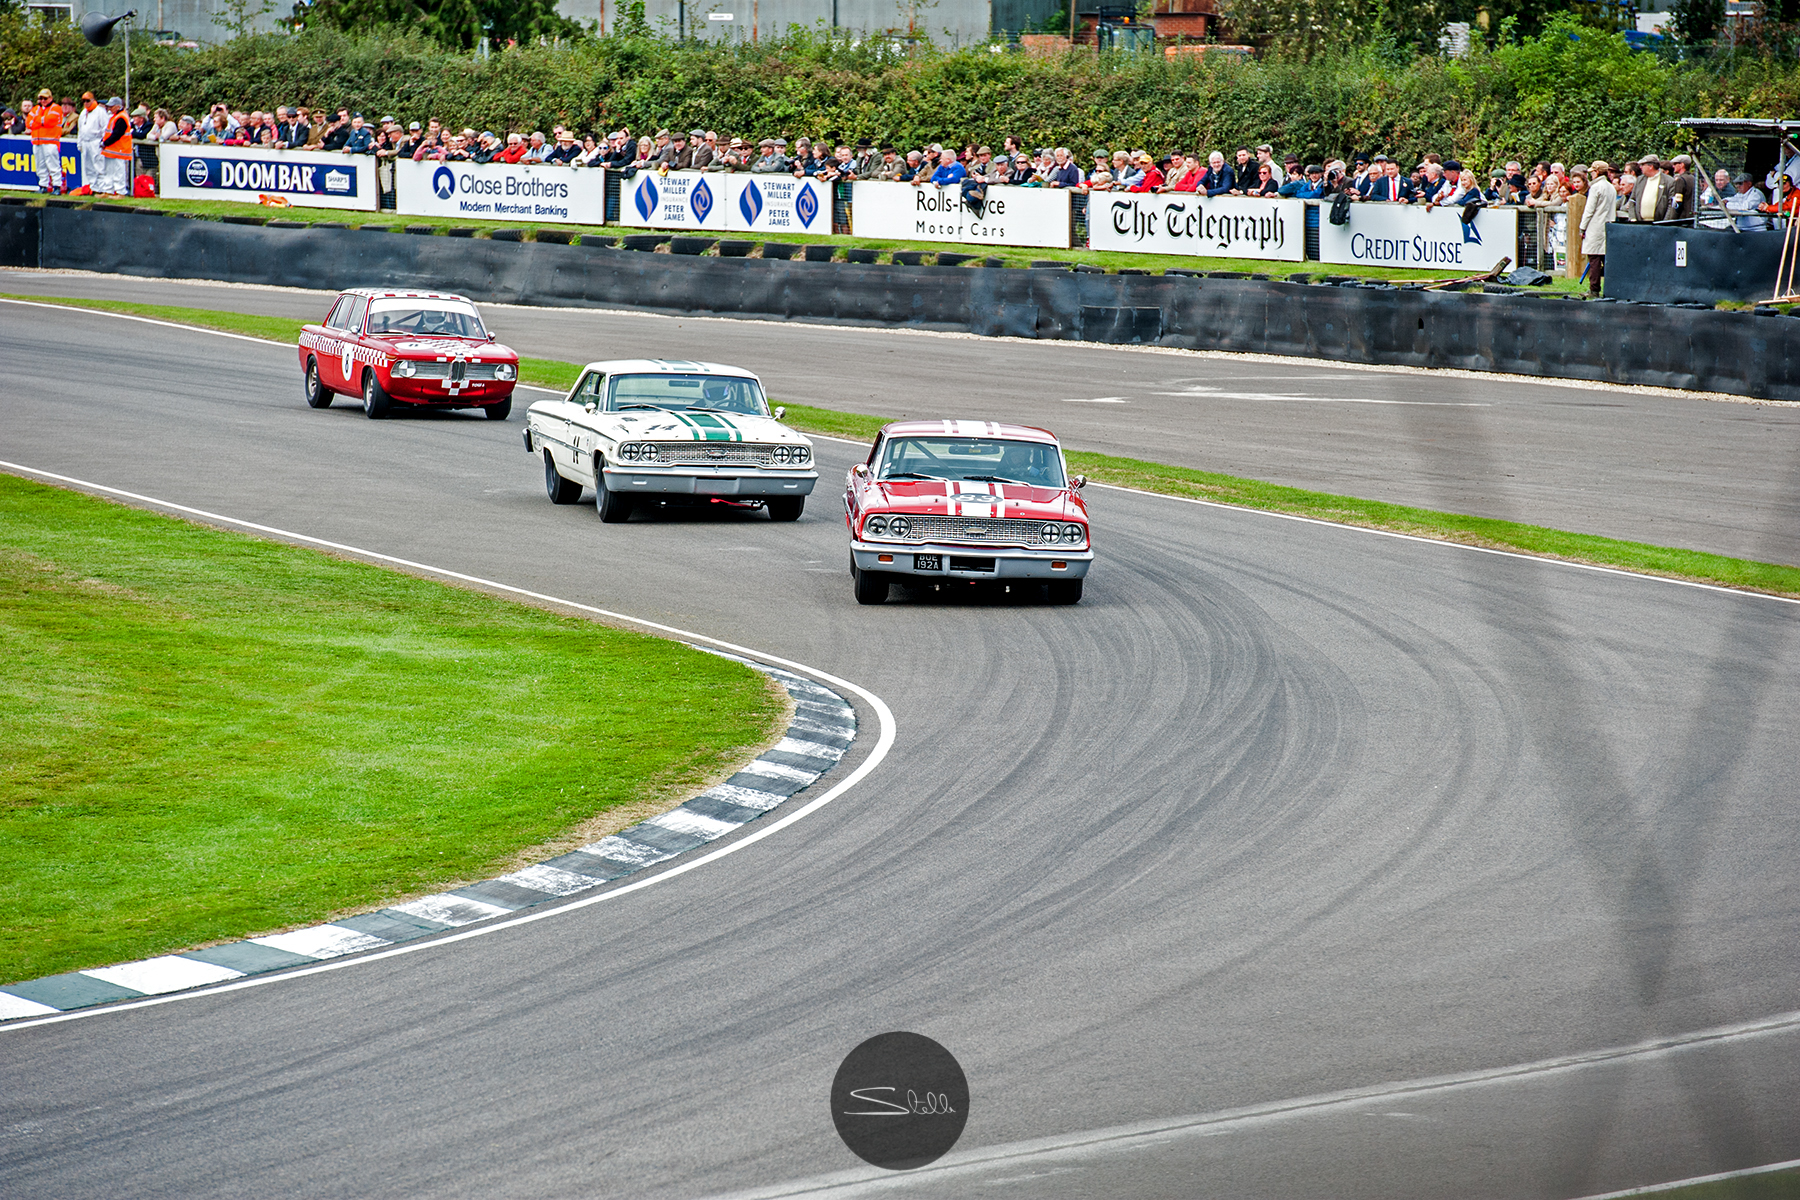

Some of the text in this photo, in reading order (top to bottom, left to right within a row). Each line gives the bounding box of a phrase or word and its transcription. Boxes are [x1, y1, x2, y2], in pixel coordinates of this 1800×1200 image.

[221, 161, 276, 189] DOOM
[278, 164, 315, 191] BAR
[460, 174, 568, 198] Close Brothers
[659, 177, 690, 186] STEWART
[763, 182, 795, 190] STEWART
[663, 186, 686, 195] MILLER
[767, 191, 791, 199] MILLER
[460, 201, 568, 218] Modern Merchant Banking
[664, 204, 684, 212] PETER
[917, 190, 1005, 220] Rolls-Ryce
[664, 213, 685, 221] JAMES
[769, 209, 789, 217] PETER
[769, 218, 790, 226] JAMES
[1111, 200, 1285, 250] The Telegraph
[916, 220, 1005, 237] Motor Cars
[1351, 232, 1463, 264] CREDIT SUISSE
[917, 560, 939, 570] 192A
